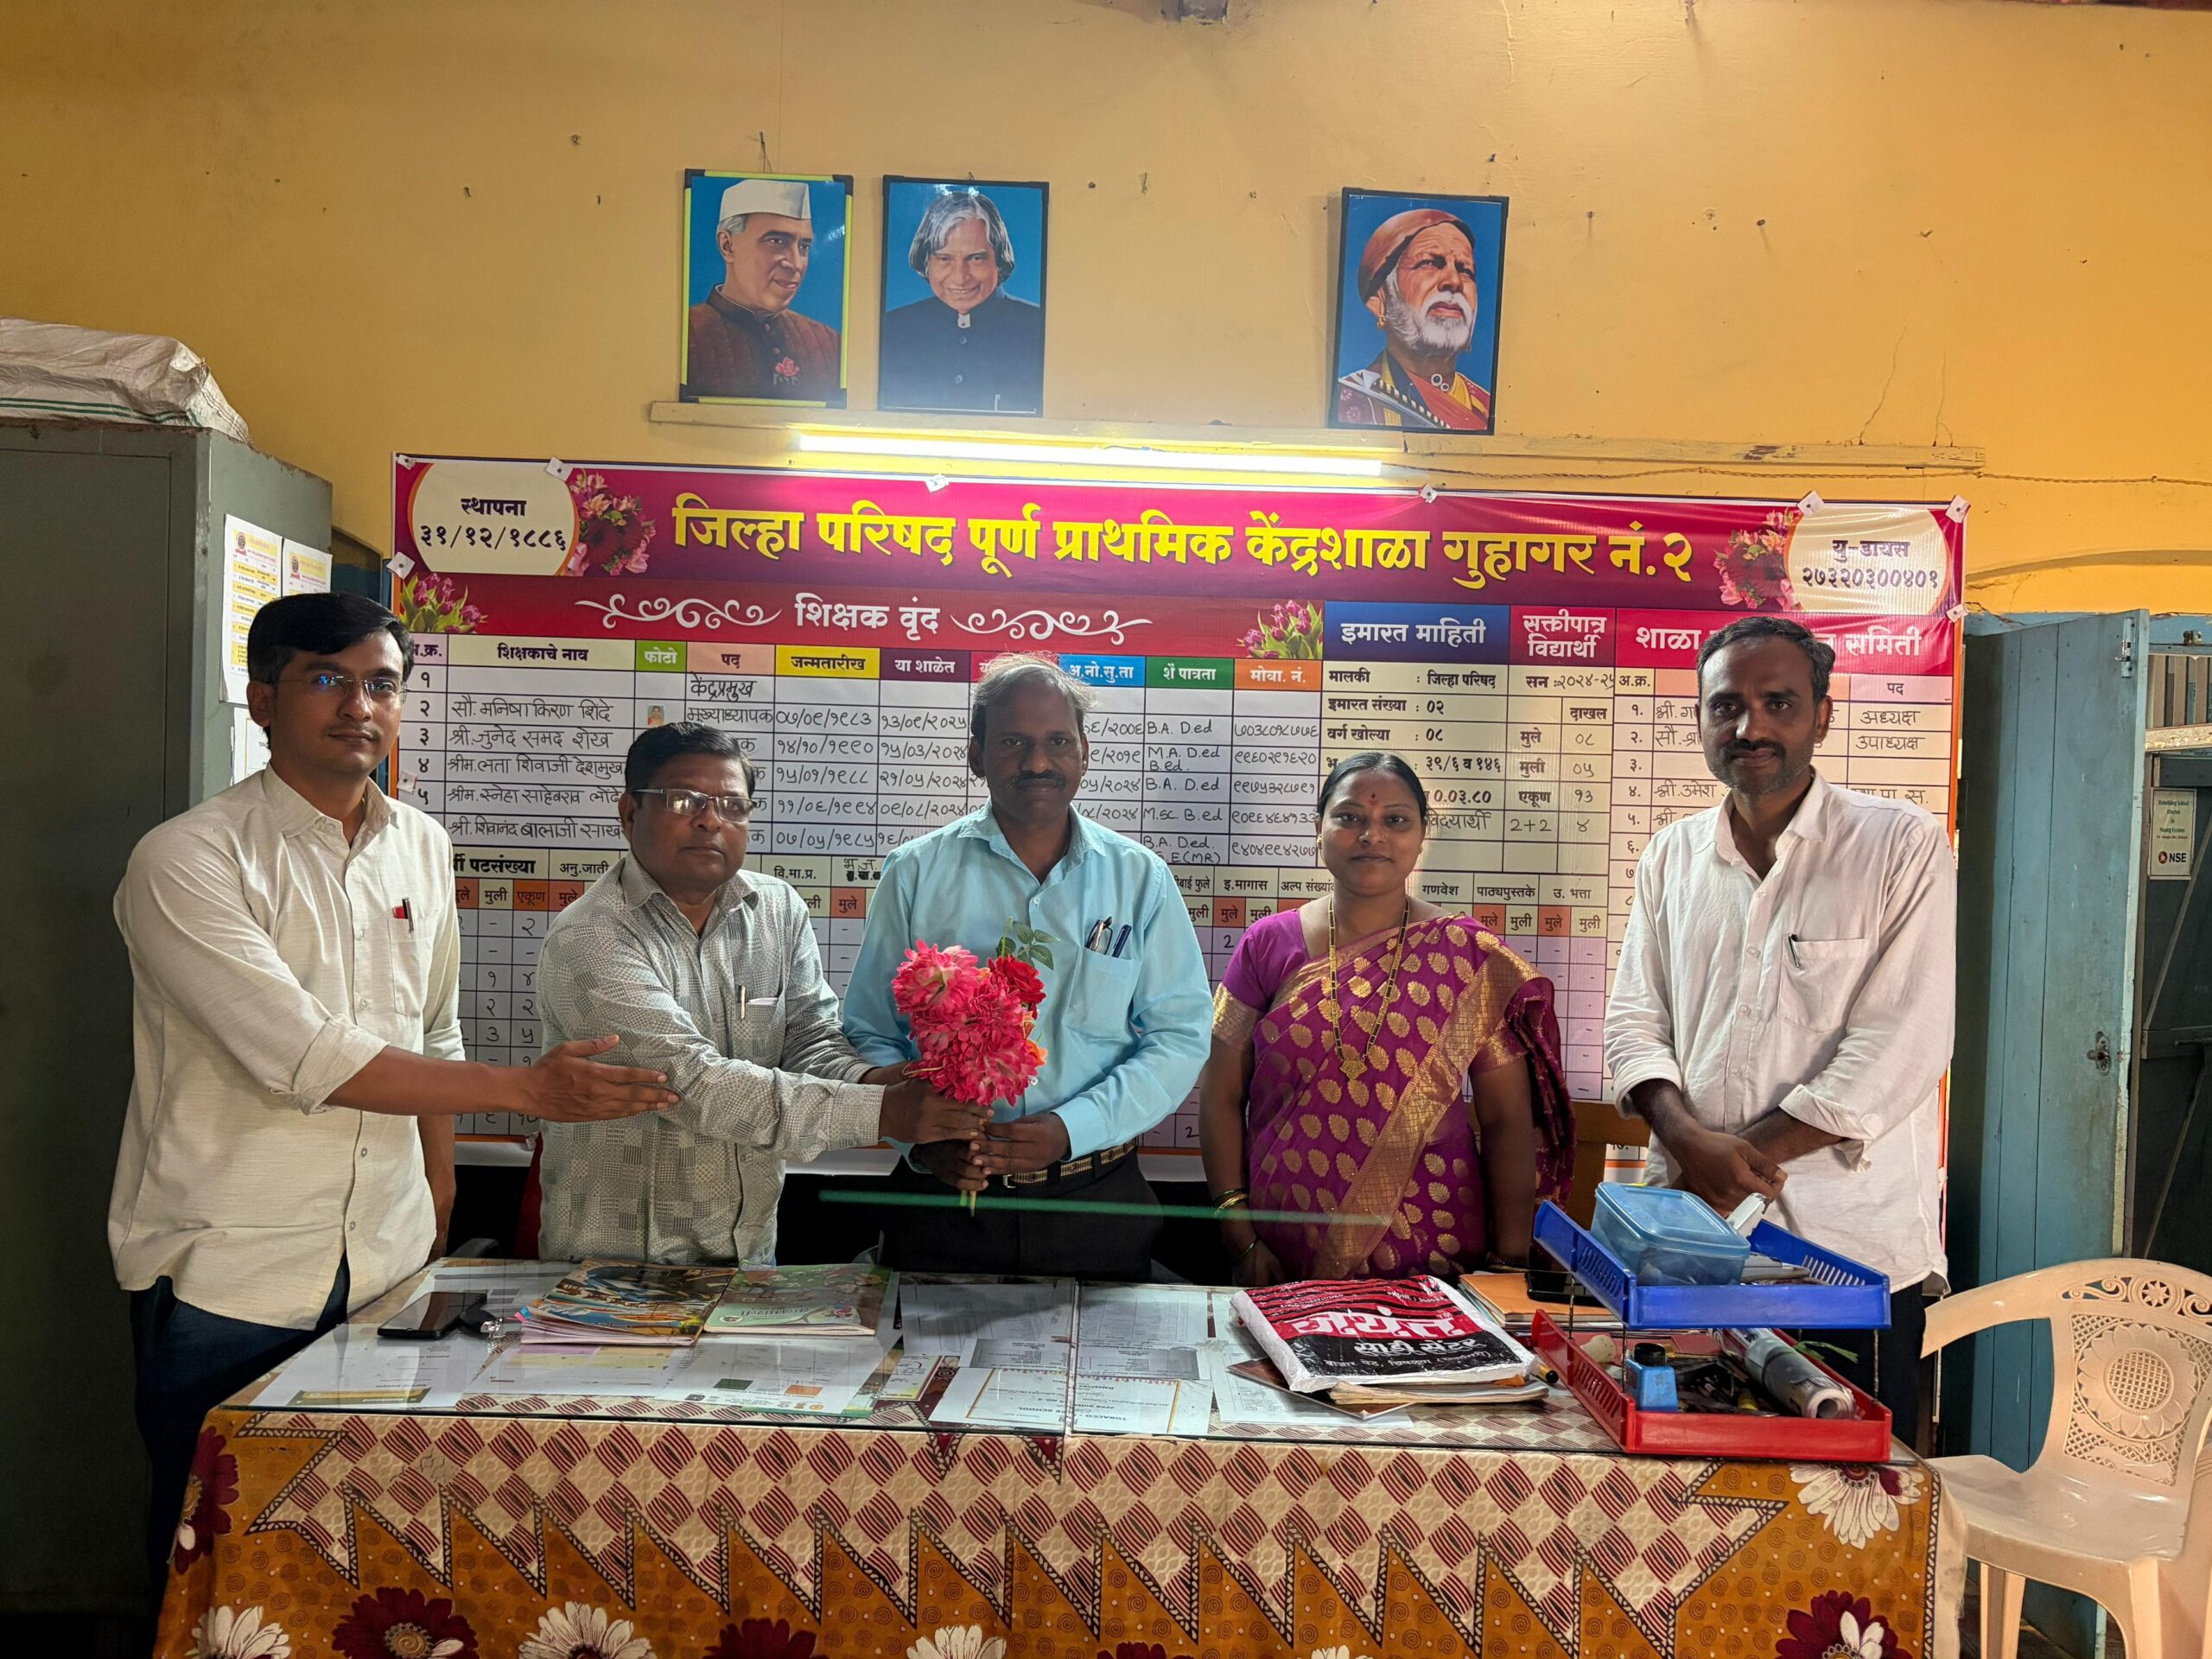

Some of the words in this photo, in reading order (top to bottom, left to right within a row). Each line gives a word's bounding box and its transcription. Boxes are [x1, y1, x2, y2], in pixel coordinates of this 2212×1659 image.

[461, 496, 526, 518] स्थापना
[419, 524, 567, 552] ३१/१२/१८८६
[672, 492, 804, 561] जिल्हा
[817, 499, 956, 567] परिषद
[969, 502, 1040, 578] पूर्ण
[1052, 508, 1234, 565] प्राथमिक
[1246, 511, 1431, 577] केंद्रशाळा
[1443, 531, 1597, 589] गुहागर
[1833, 540, 1910, 563] यु-डायस
[1802, 566, 1938, 588] २७३२०३००४०१
[795, 591, 890, 630] शिक्षक
[899, 597, 940, 641] वृंद
[1341, 620, 1408, 644] इमारत
[1415, 617, 1487, 649] माहिती
[1636, 625, 1700, 651] शाळा
[1845, 626, 1922, 657] समिती
[498, 643, 558, 662] शिक्षकाचे
[563, 647, 589, 662] नाव
[1528, 633, 1597, 658] विद्यार्थी
[645, 650, 677, 665] फोटो
[721, 653, 741, 668] पद
[791, 654, 866, 671] जन्मतारीख
[894, 659, 913, 672] या
[915, 658, 956, 674] शाळेत
[421, 671, 430, 688] १
[1179, 667, 1217, 681] पात्रता
[1329, 667, 1370, 683] मालकी
[1427, 670, 1459, 686] जिल्हा
[1462, 671, 1496, 689] परिषद
[1619, 676, 1651, 688] अ.क्र.
[1526, 677, 1548, 689] सन
[1887, 683, 1904, 695] पद
[420, 700, 430, 716] २
[578, 698, 614, 722] शिंदे
[1328, 698, 1368, 712] इमारत
[1371, 696, 1407, 713] संख्या
[1427, 700, 1445, 715] ०२
[1570, 707, 1608, 723] दाखल
[1859, 709, 1921, 726] अध्यक्ष
[420, 728, 429, 746] ३
[1328, 727, 1348, 741] वर्ग
[1351, 724, 1390, 742] खोल्या
[1426, 728, 1443, 741] ०८
[1520, 728, 1541, 748] मुले
[1855, 735, 1926, 751] उपाध्यक्ष
[418, 758, 429, 773] ४
[517, 753, 573, 775] शिवाजी
[1519, 760, 1546, 779] मुली
[417, 788, 429, 804] ५
[1518, 790, 1551, 808] एकूण
[580, 820, 624, 840] साख
[469, 855, 536, 874] पटसंख्या
[2169, 852, 2187, 863] NSE
[1224, 879, 1268, 892] इ.मागास
[1281, 880, 1302, 892] अल्प
[1422, 882, 1459, 897] गणवेश
[1477, 884, 1535, 900] पाठ्यपुस्तके
[485, 887, 507, 905] मुली
[518, 891, 545, 905] एकूण
[838, 895, 858, 912] मुले
[1221, 906, 1238, 922] मुले
[1510, 911, 1533, 928] मुली
[1545, 913, 1563, 929] मुले
[1579, 915, 1601, 932] मुली
